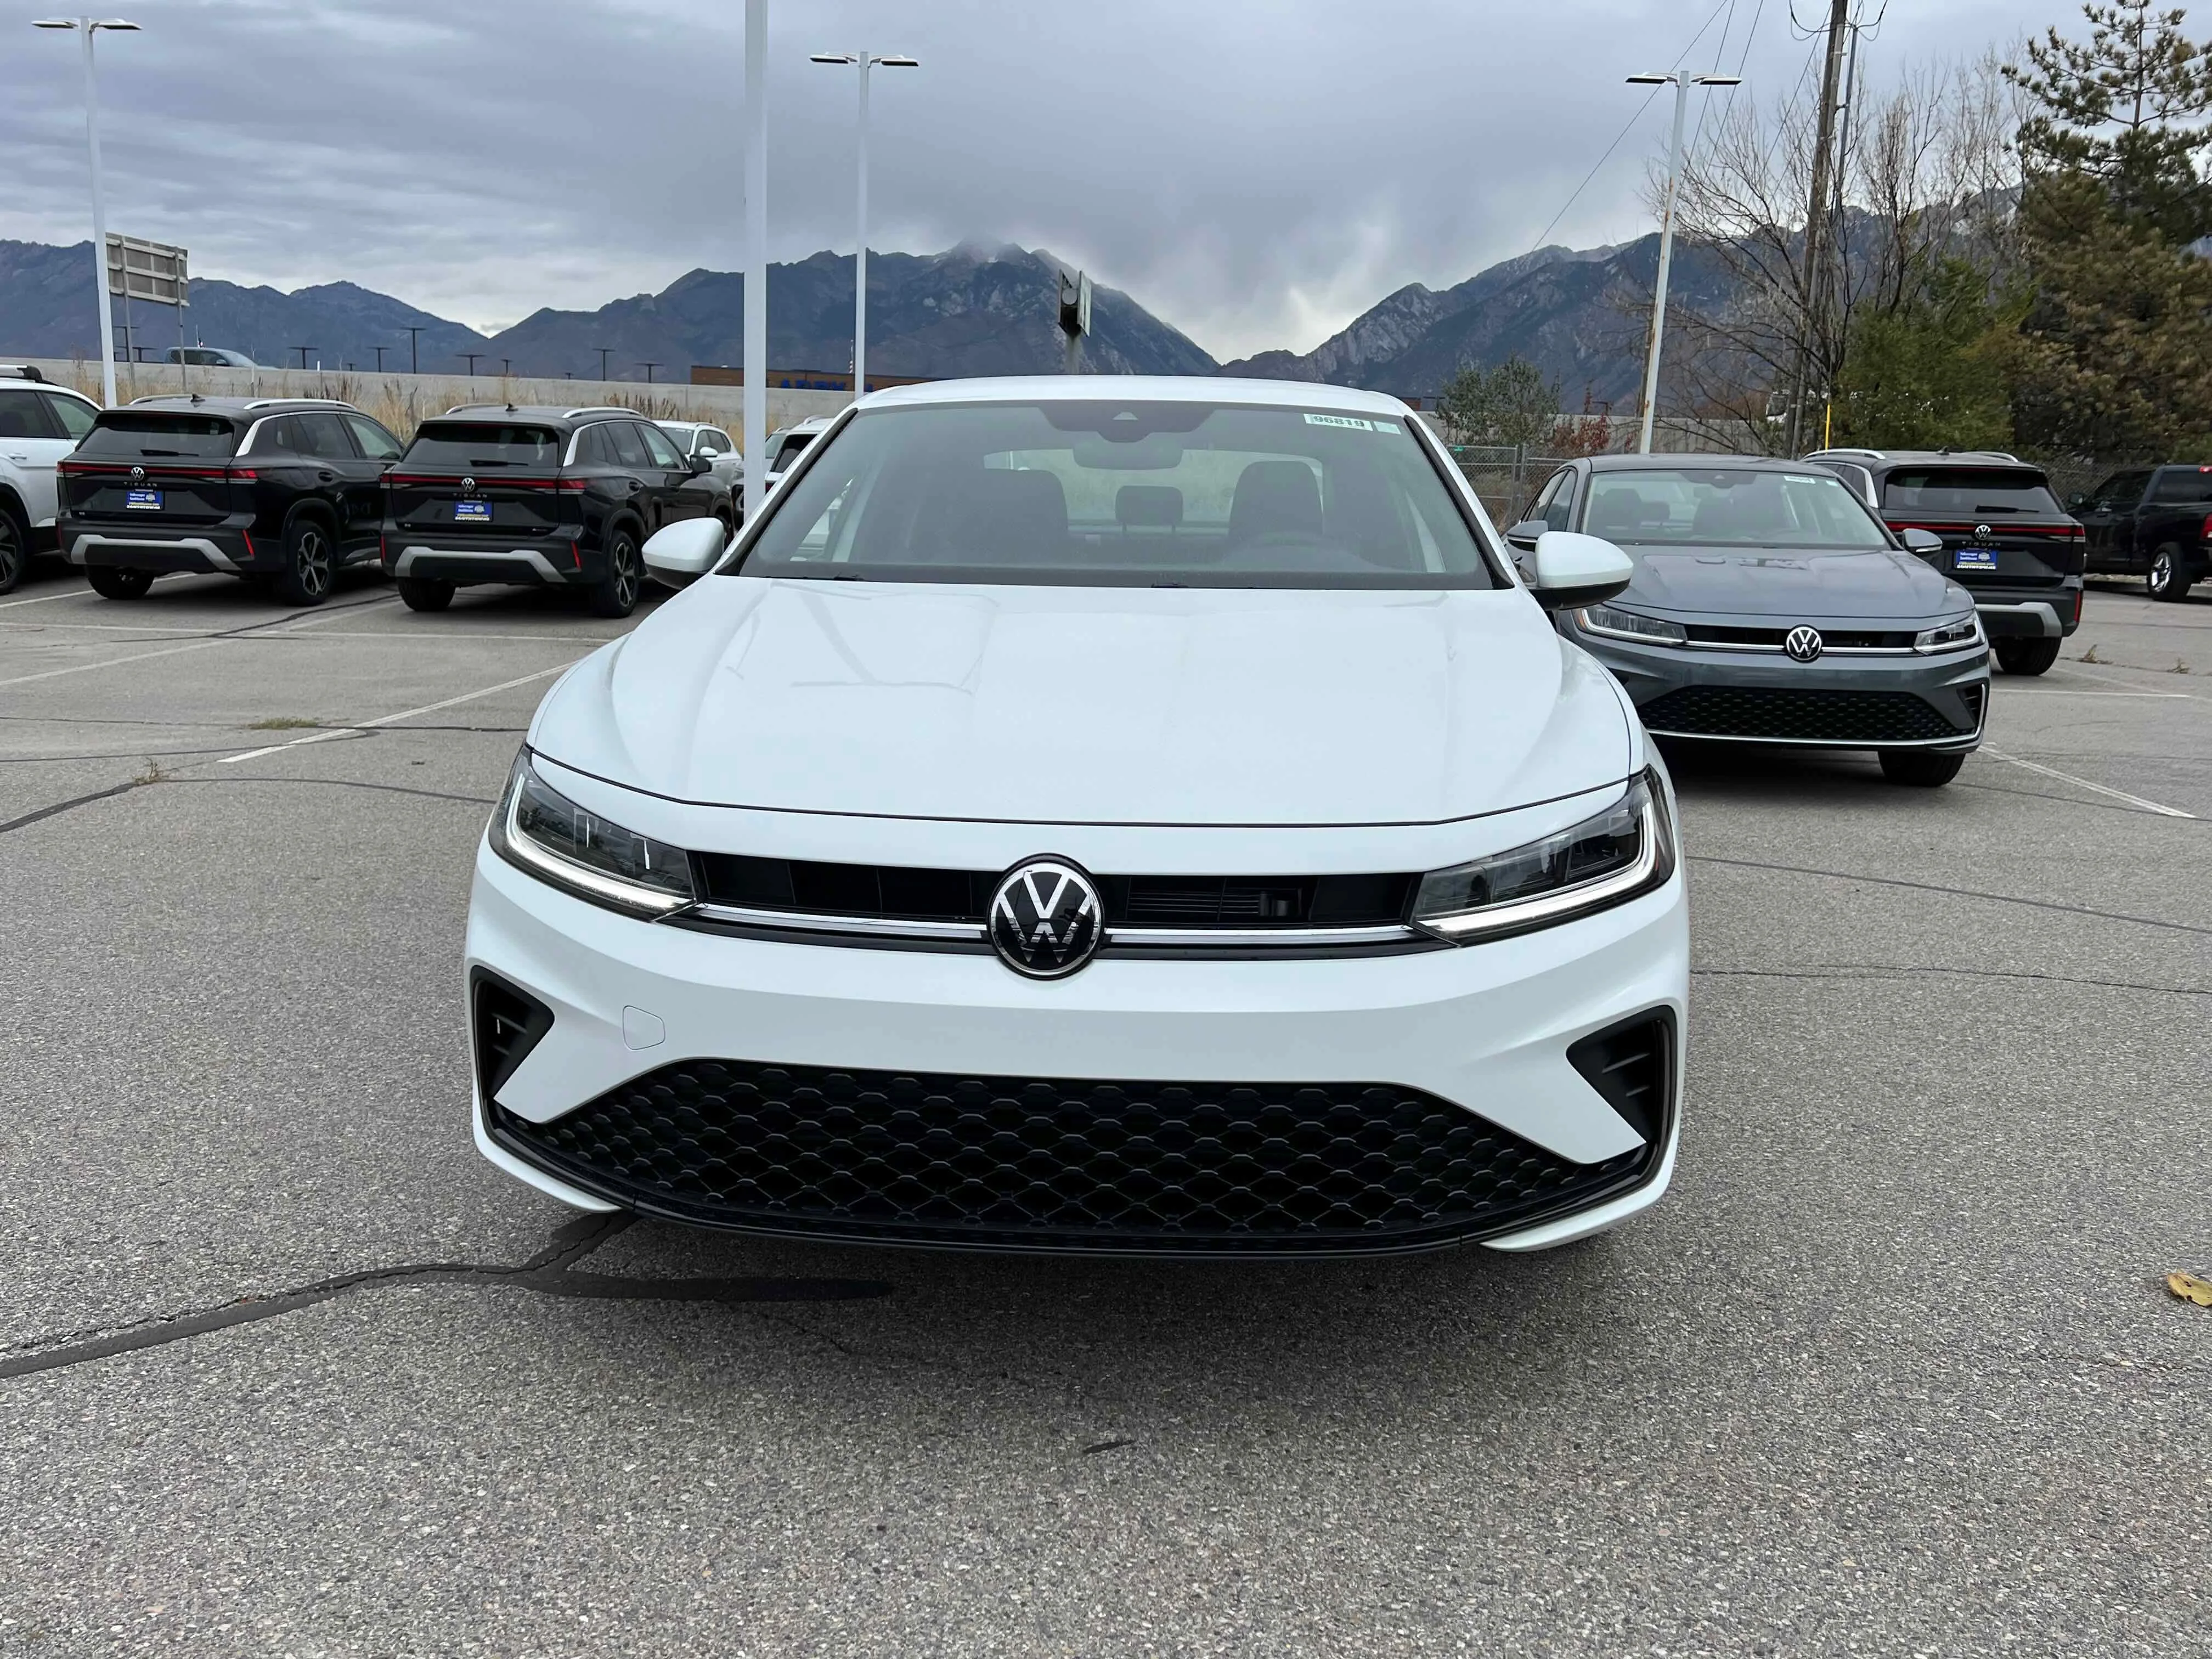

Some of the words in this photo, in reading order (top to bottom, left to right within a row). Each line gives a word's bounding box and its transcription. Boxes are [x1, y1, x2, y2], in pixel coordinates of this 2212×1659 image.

[1314, 415, 1365, 427] 96819
[1786, 627, 1822, 661] VW
[991, 862, 1101, 975] VW
